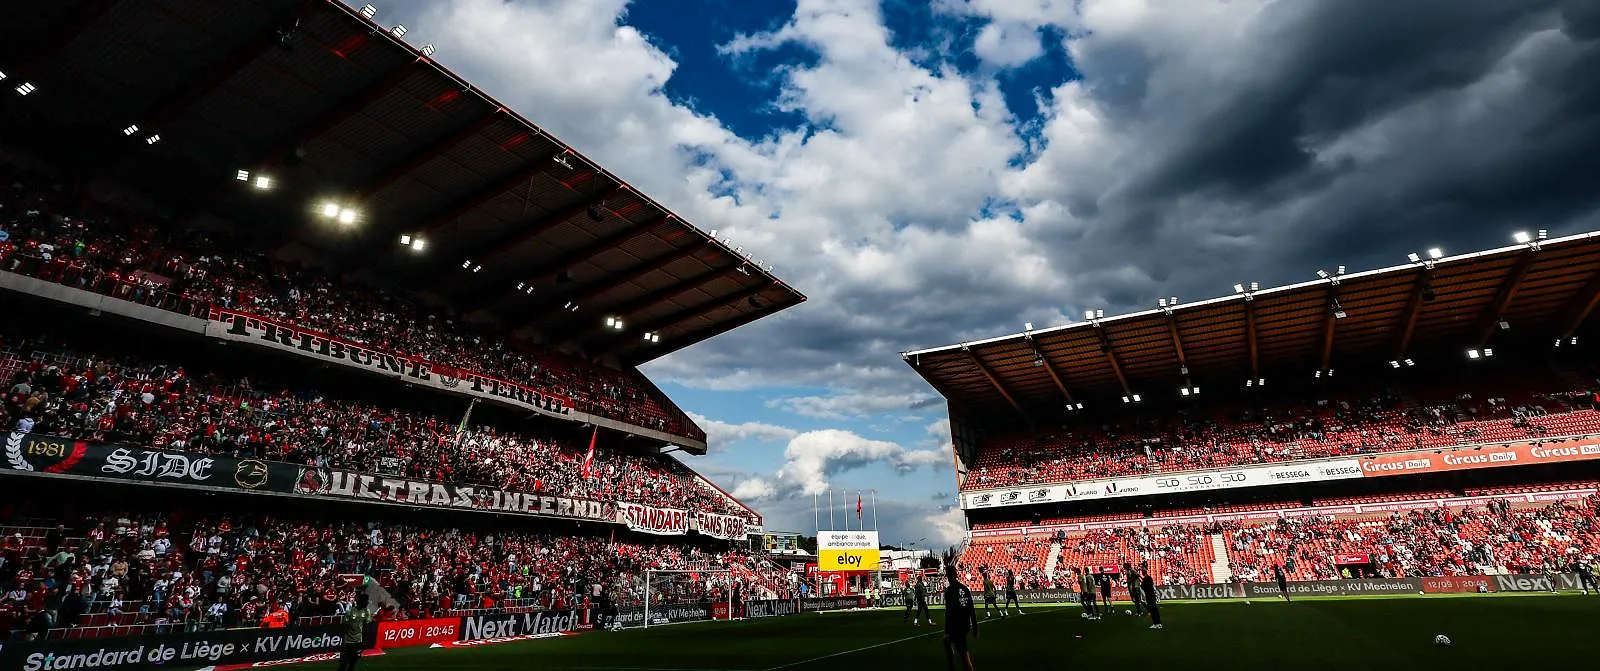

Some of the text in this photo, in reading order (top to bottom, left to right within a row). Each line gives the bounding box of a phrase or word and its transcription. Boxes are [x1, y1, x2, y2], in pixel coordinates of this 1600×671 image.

[219, 311, 432, 380] TRIBUNE
[27, 440, 65, 458] 1981
[1531, 445, 1600, 458] Circus Dail
[101, 447, 215, 481] SIDE
[1363, 460, 1428, 472] Circus Daily
[1443, 452, 1513, 465] Circus Daily
[1275, 471, 1310, 479] BESSEGA
[1325, 467, 1361, 476] BESSEGA
[331, 471, 473, 507] ULTRAS
[837, 552, 862, 567] eloy
[1180, 585, 1233, 599] Match
[1253, 584, 1296, 593] Standrd
[1298, 583, 1310, 592] de
[1347, 583, 1361, 591] KV
[1364, 582, 1413, 591] Mechelen
[746, 601, 768, 617] Next
[384, 625, 454, 641] 12/09 20:45
[464, 611, 579, 641] Next Match
[24, 645, 145, 671] Standard
[148, 643, 176, 662] de
[180, 642, 234, 662] Liège
[254, 636, 283, 654] KV
